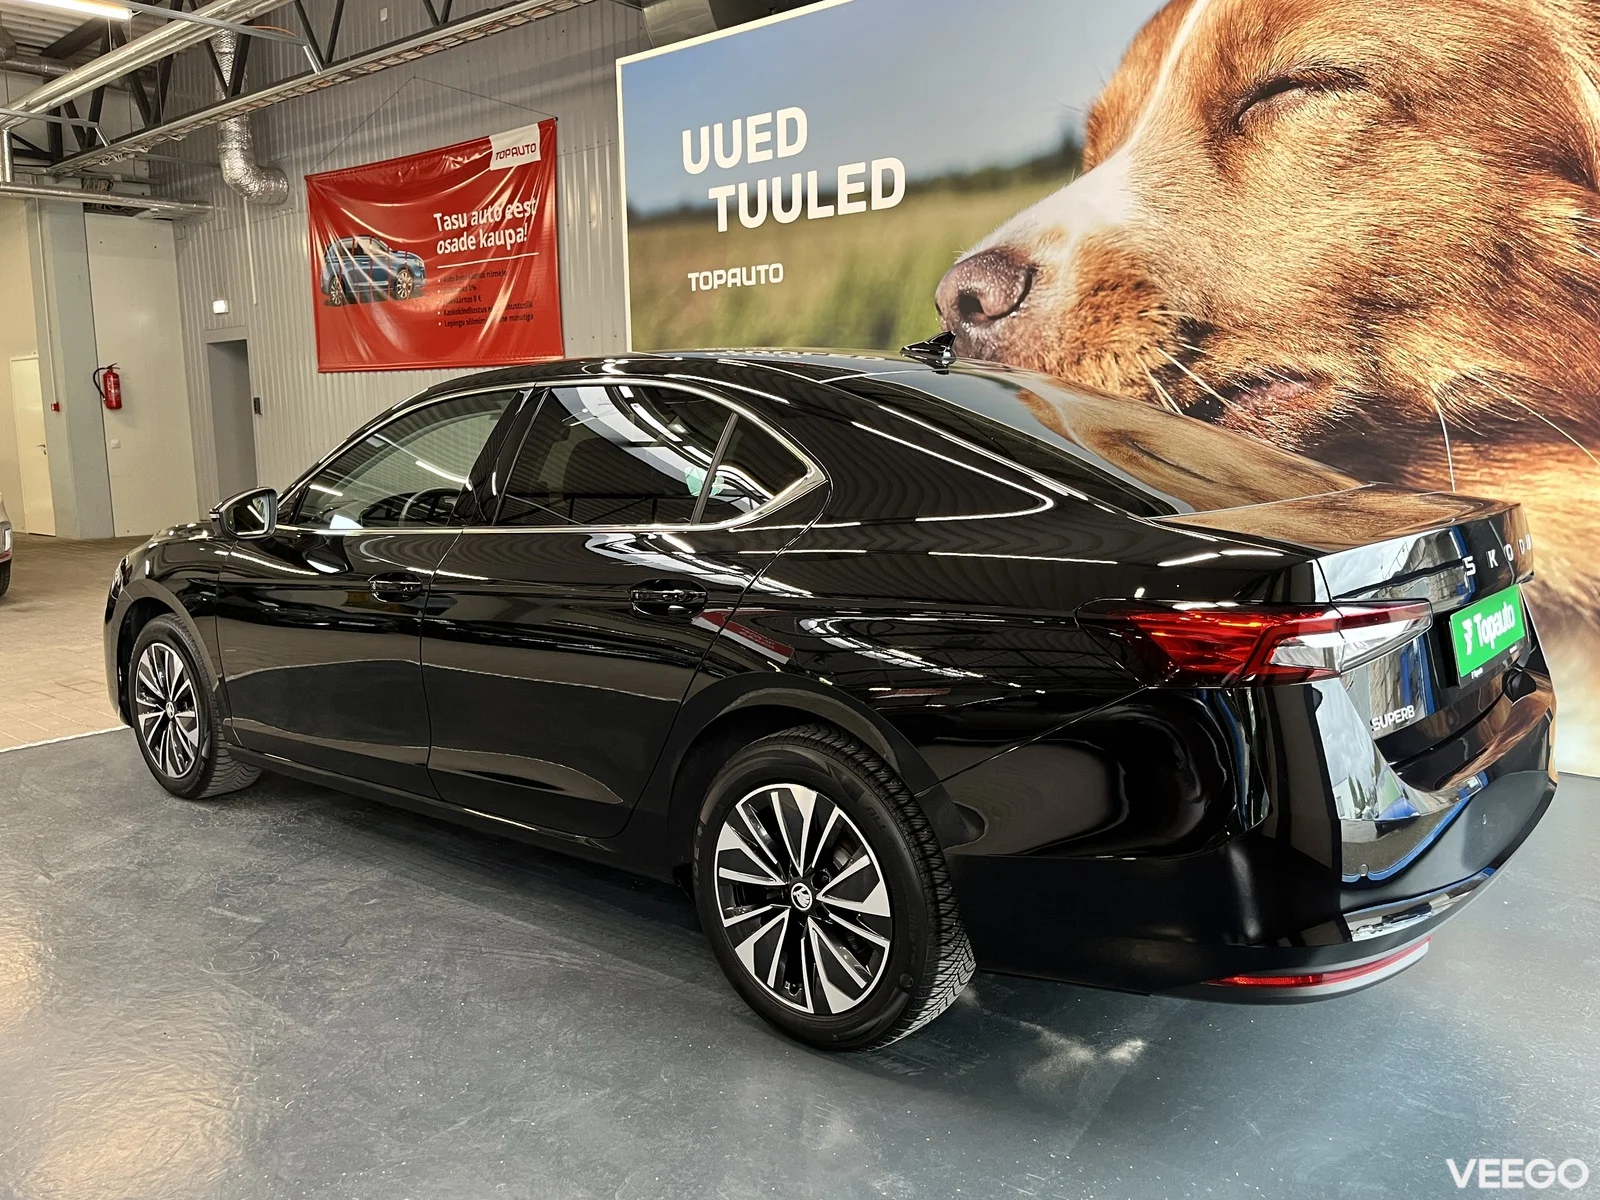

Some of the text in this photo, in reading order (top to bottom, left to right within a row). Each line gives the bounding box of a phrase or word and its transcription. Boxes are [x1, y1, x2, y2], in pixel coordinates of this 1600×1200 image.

[495, 143, 537, 160] TOPAUTO
[682, 106, 808, 175] UUED
[708, 157, 906, 233] TUULED
[433, 198, 537, 232] Tasu auto eest
[436, 222, 528, 255] osade kaupa!
[687, 263, 784, 292] TOPAUTO
[1473, 601, 1516, 649] Topauto
[1371, 705, 1415, 731] SUPERB
